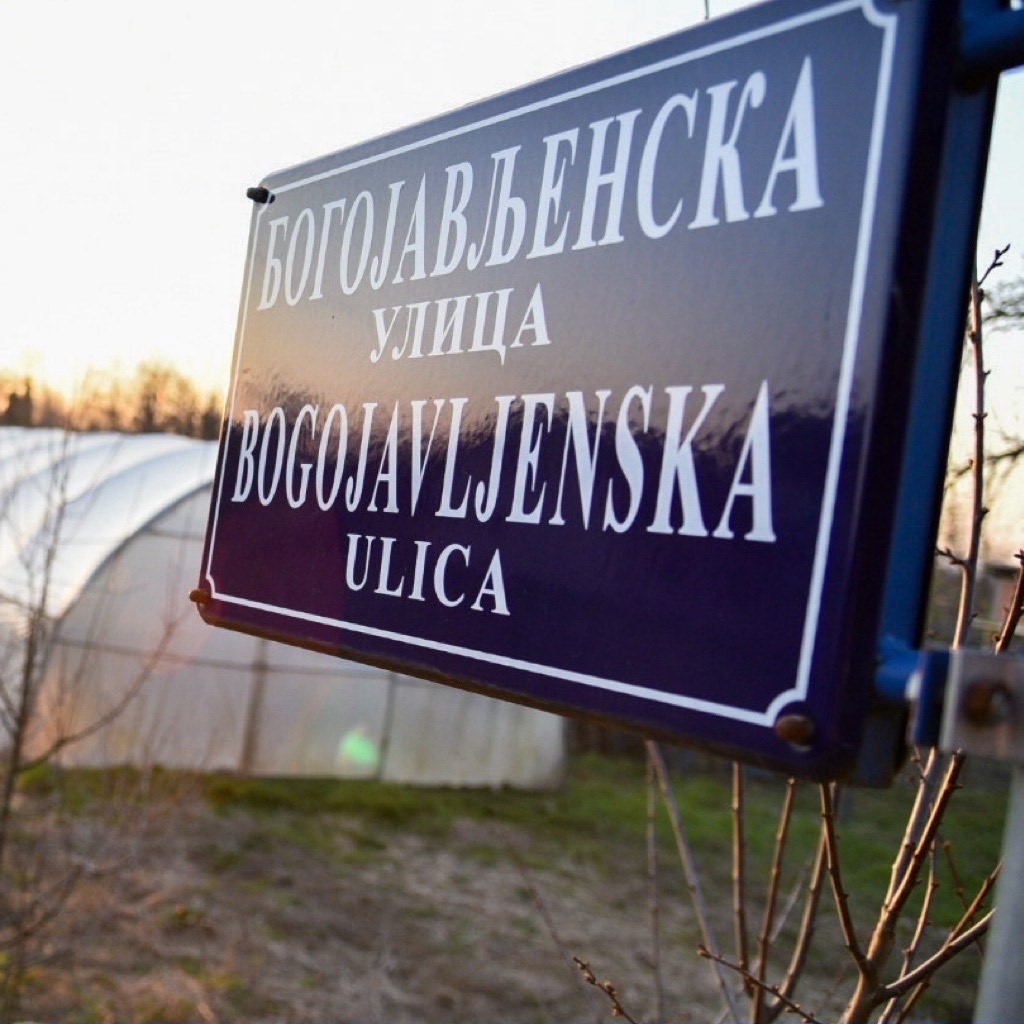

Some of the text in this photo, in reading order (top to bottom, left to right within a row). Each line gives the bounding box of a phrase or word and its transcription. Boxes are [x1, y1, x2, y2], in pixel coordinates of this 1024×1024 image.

[256, 55, 824, 312] БОГОЈАВЉЕНСКА
[370, 283, 552, 365] УЛИЦА
[231, 379, 777, 543] BOGOJAVLJENSKA
[345, 533, 511, 616] ULICA
